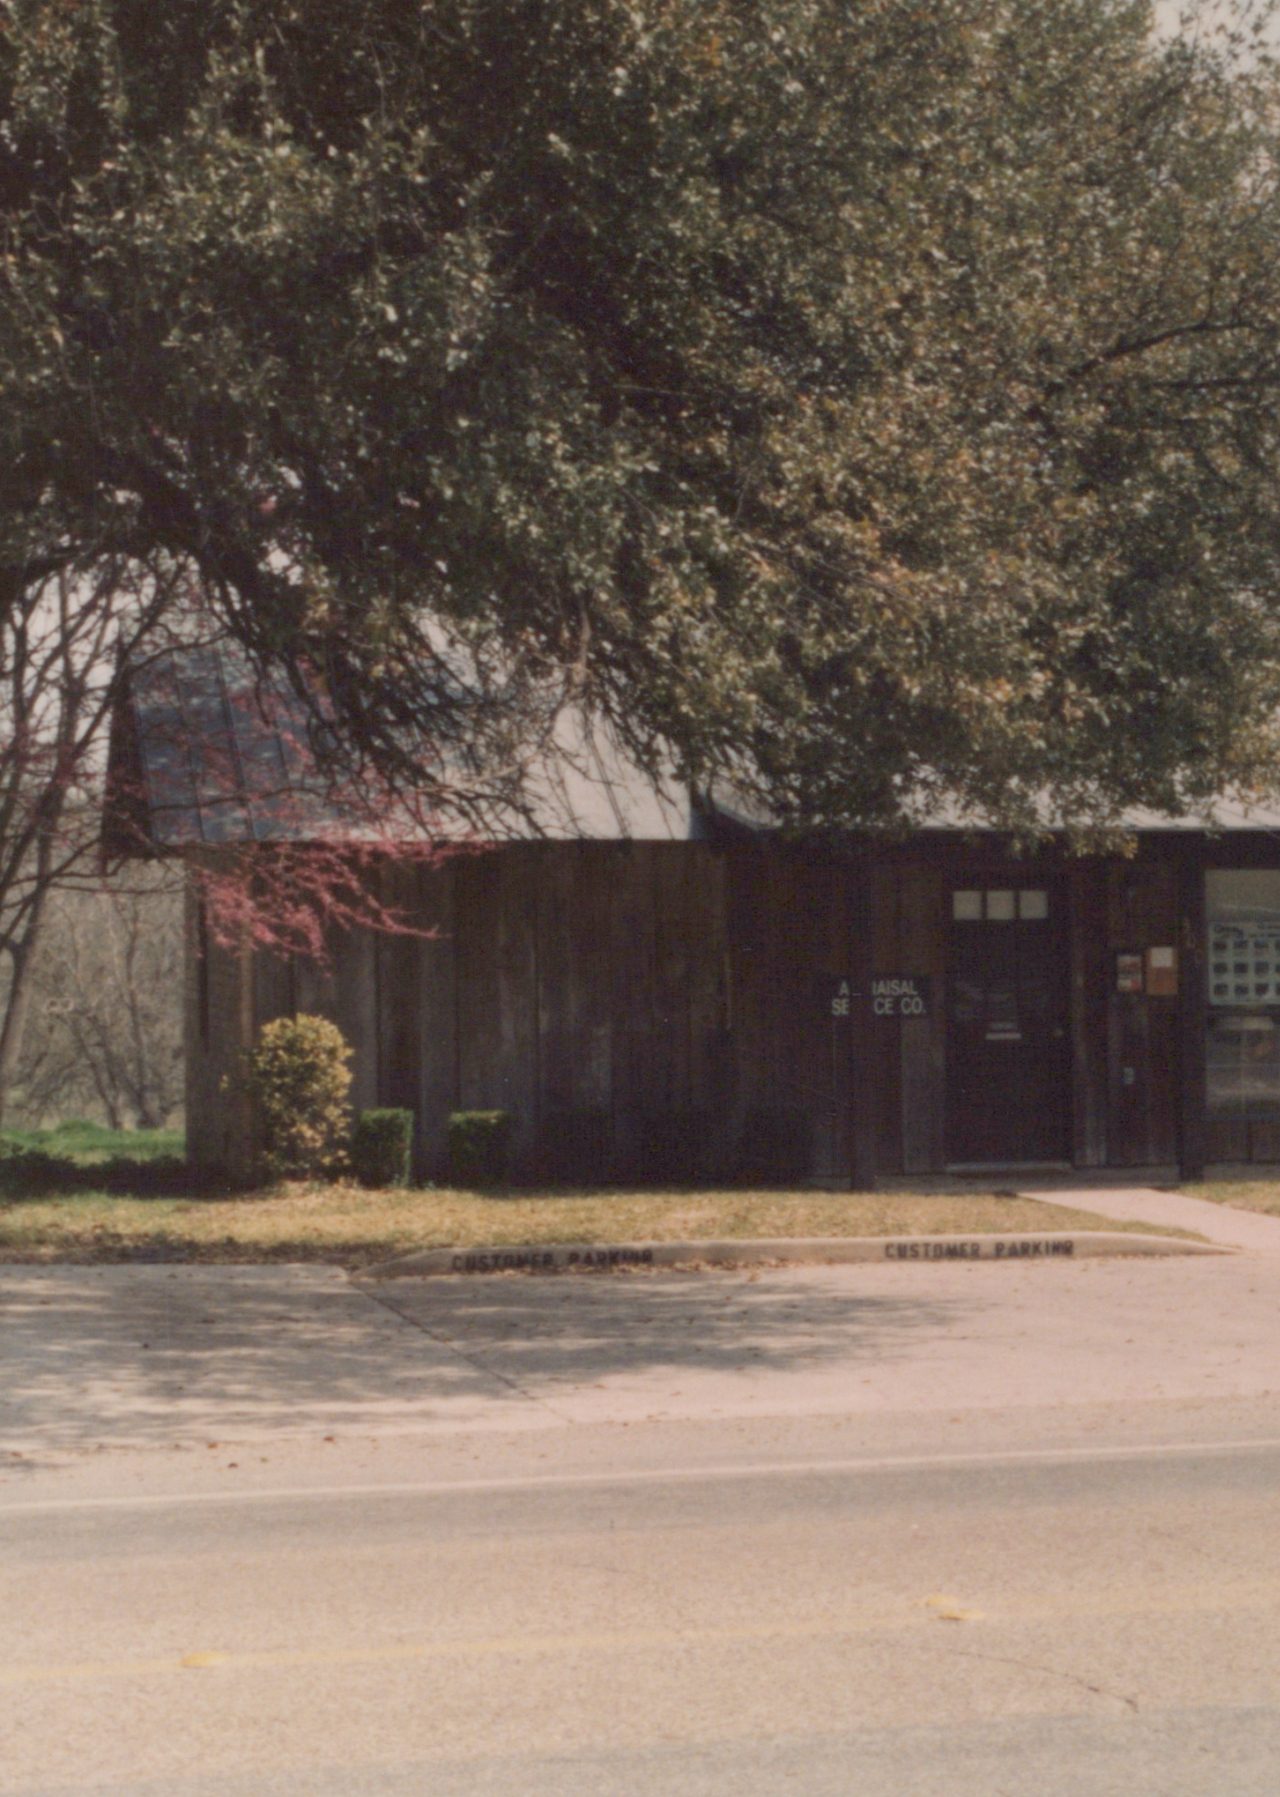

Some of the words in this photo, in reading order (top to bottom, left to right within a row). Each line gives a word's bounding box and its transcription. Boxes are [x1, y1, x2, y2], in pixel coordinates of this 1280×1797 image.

[901, 997, 927, 1015] CO.
[885, 1242, 980, 1259] CUSTOMER
[452, 1253, 554, 1271] CUSTOMER
